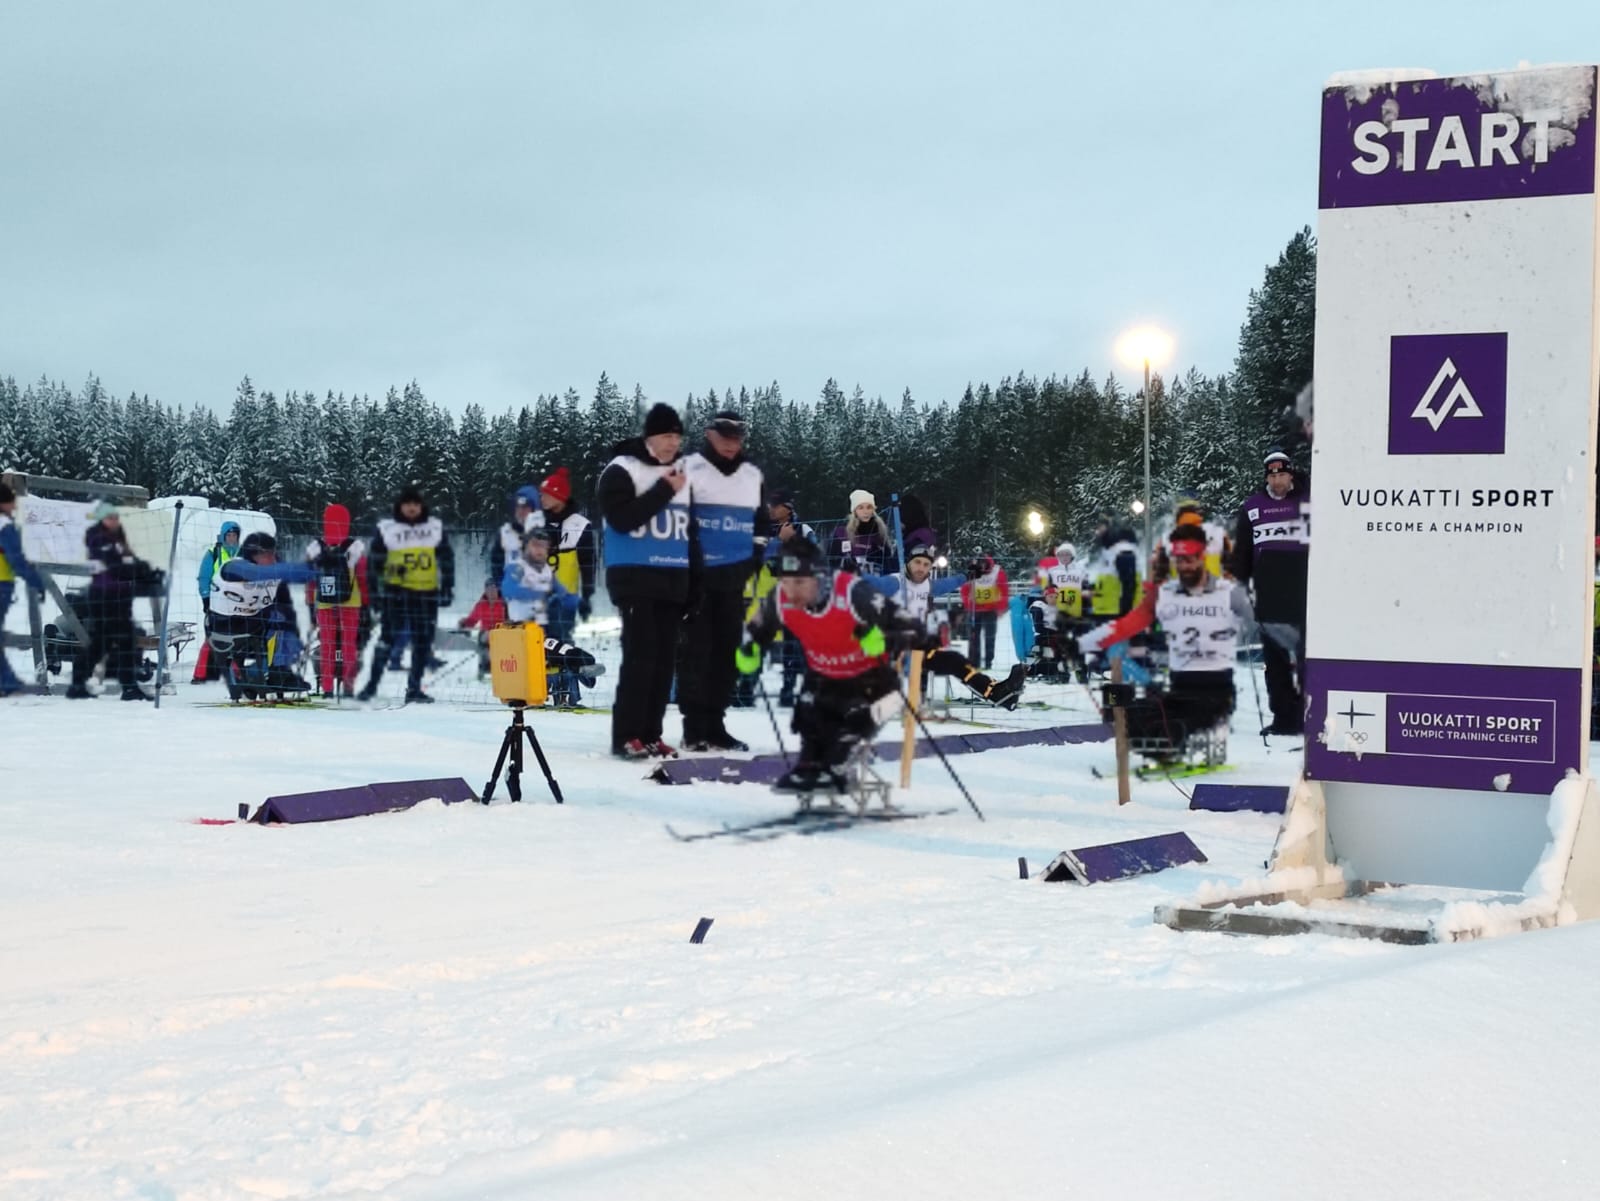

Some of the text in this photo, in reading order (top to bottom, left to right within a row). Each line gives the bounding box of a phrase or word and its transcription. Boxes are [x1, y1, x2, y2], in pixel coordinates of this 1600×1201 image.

[1351, 110, 1562, 175] START
[1340, 489, 1554, 507] VUOKATTI SPORT
[1367, 522, 1523, 533] BECOME A CHAMPION
[404, 552, 432, 570] 50
[1399, 712, 1542, 731] VUOKATTI SPORT
[1402, 729, 1538, 744] OLYMPIC TRAINING CENTER
